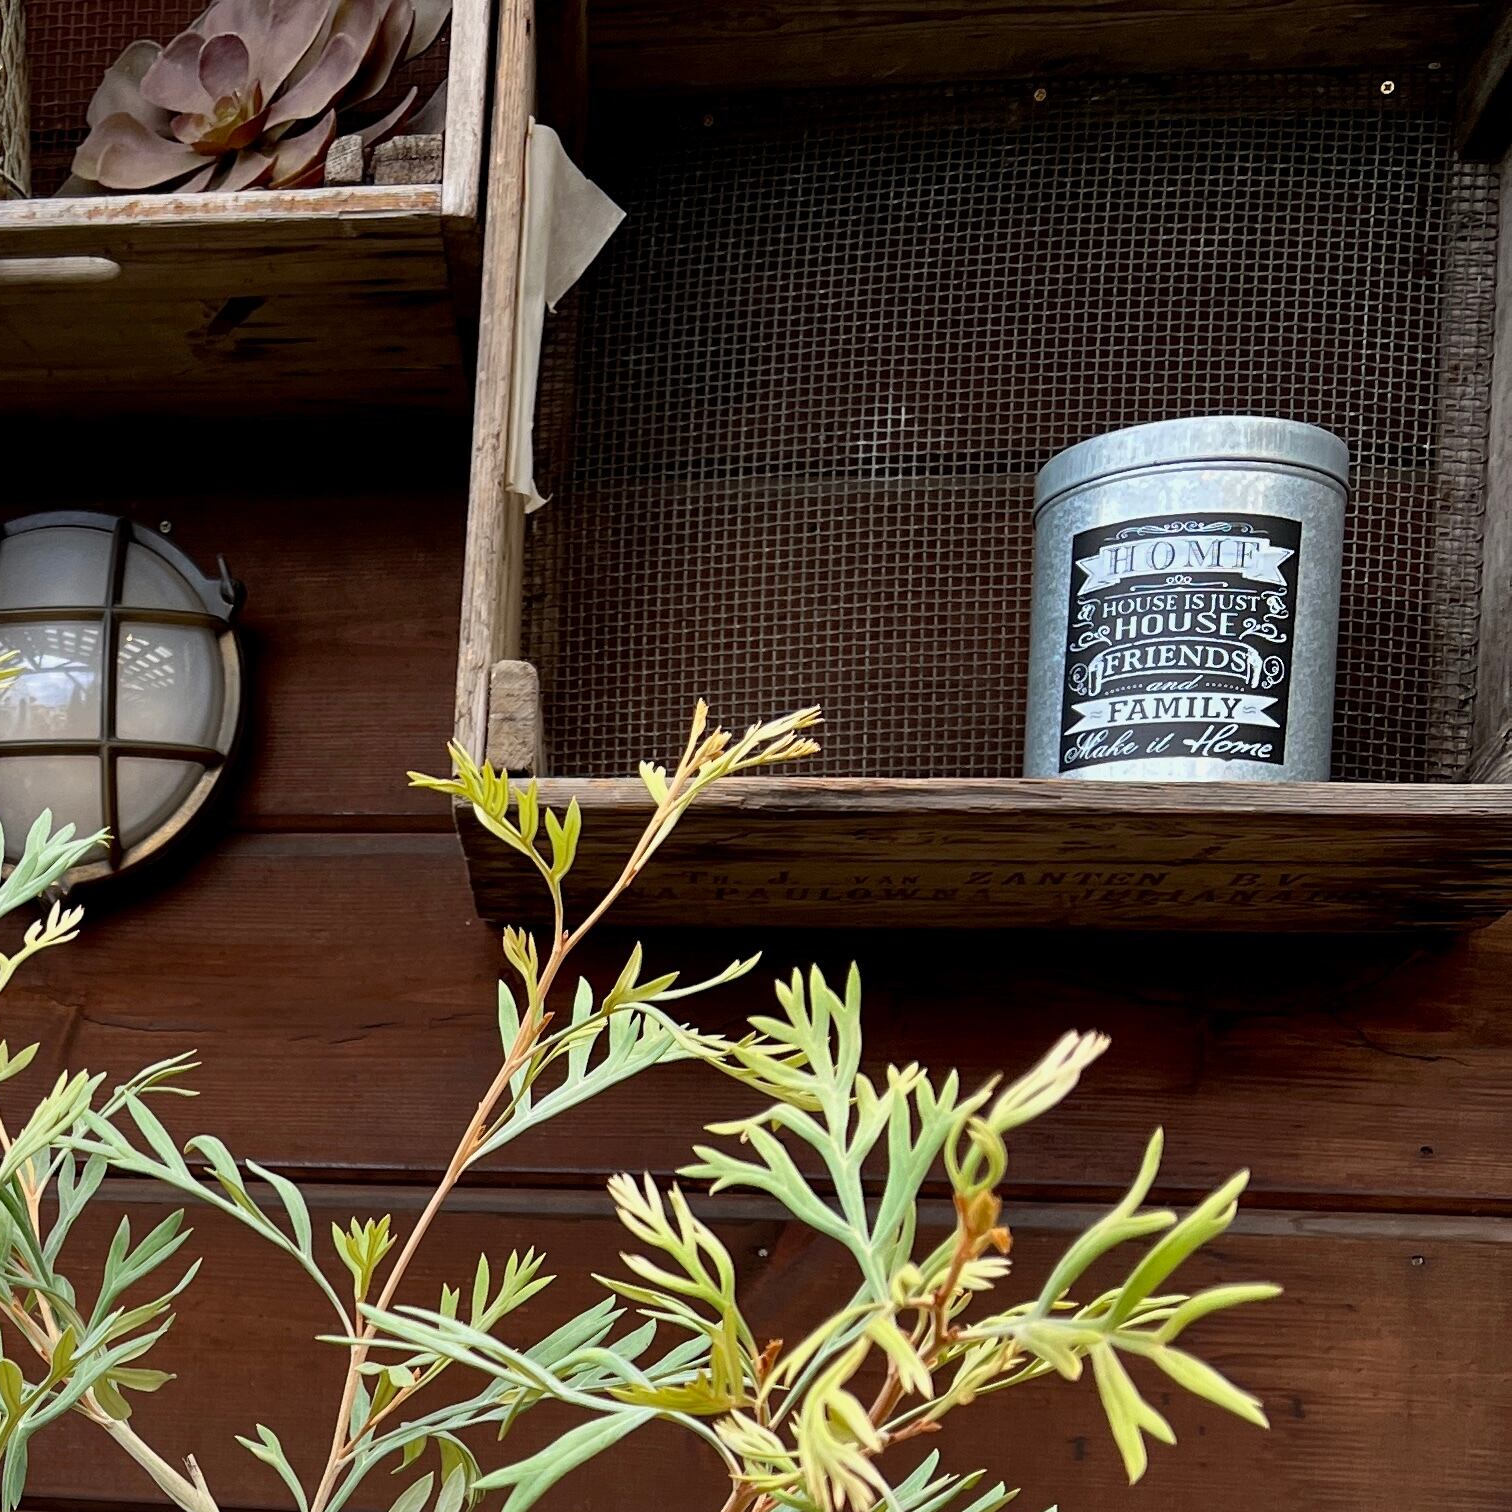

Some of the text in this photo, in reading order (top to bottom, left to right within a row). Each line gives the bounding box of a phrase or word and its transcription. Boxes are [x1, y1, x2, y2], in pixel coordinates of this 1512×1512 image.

[1102, 593, 1261, 618] HOUSE IS JUST
[1115, 612, 1239, 641] HOUSE
[1103, 645, 1250, 675] FRIENDS
[1145, 674, 1205, 692] and
[1107, 697, 1243, 723] FAMILY
[1064, 723, 1273, 764] Make it Home
